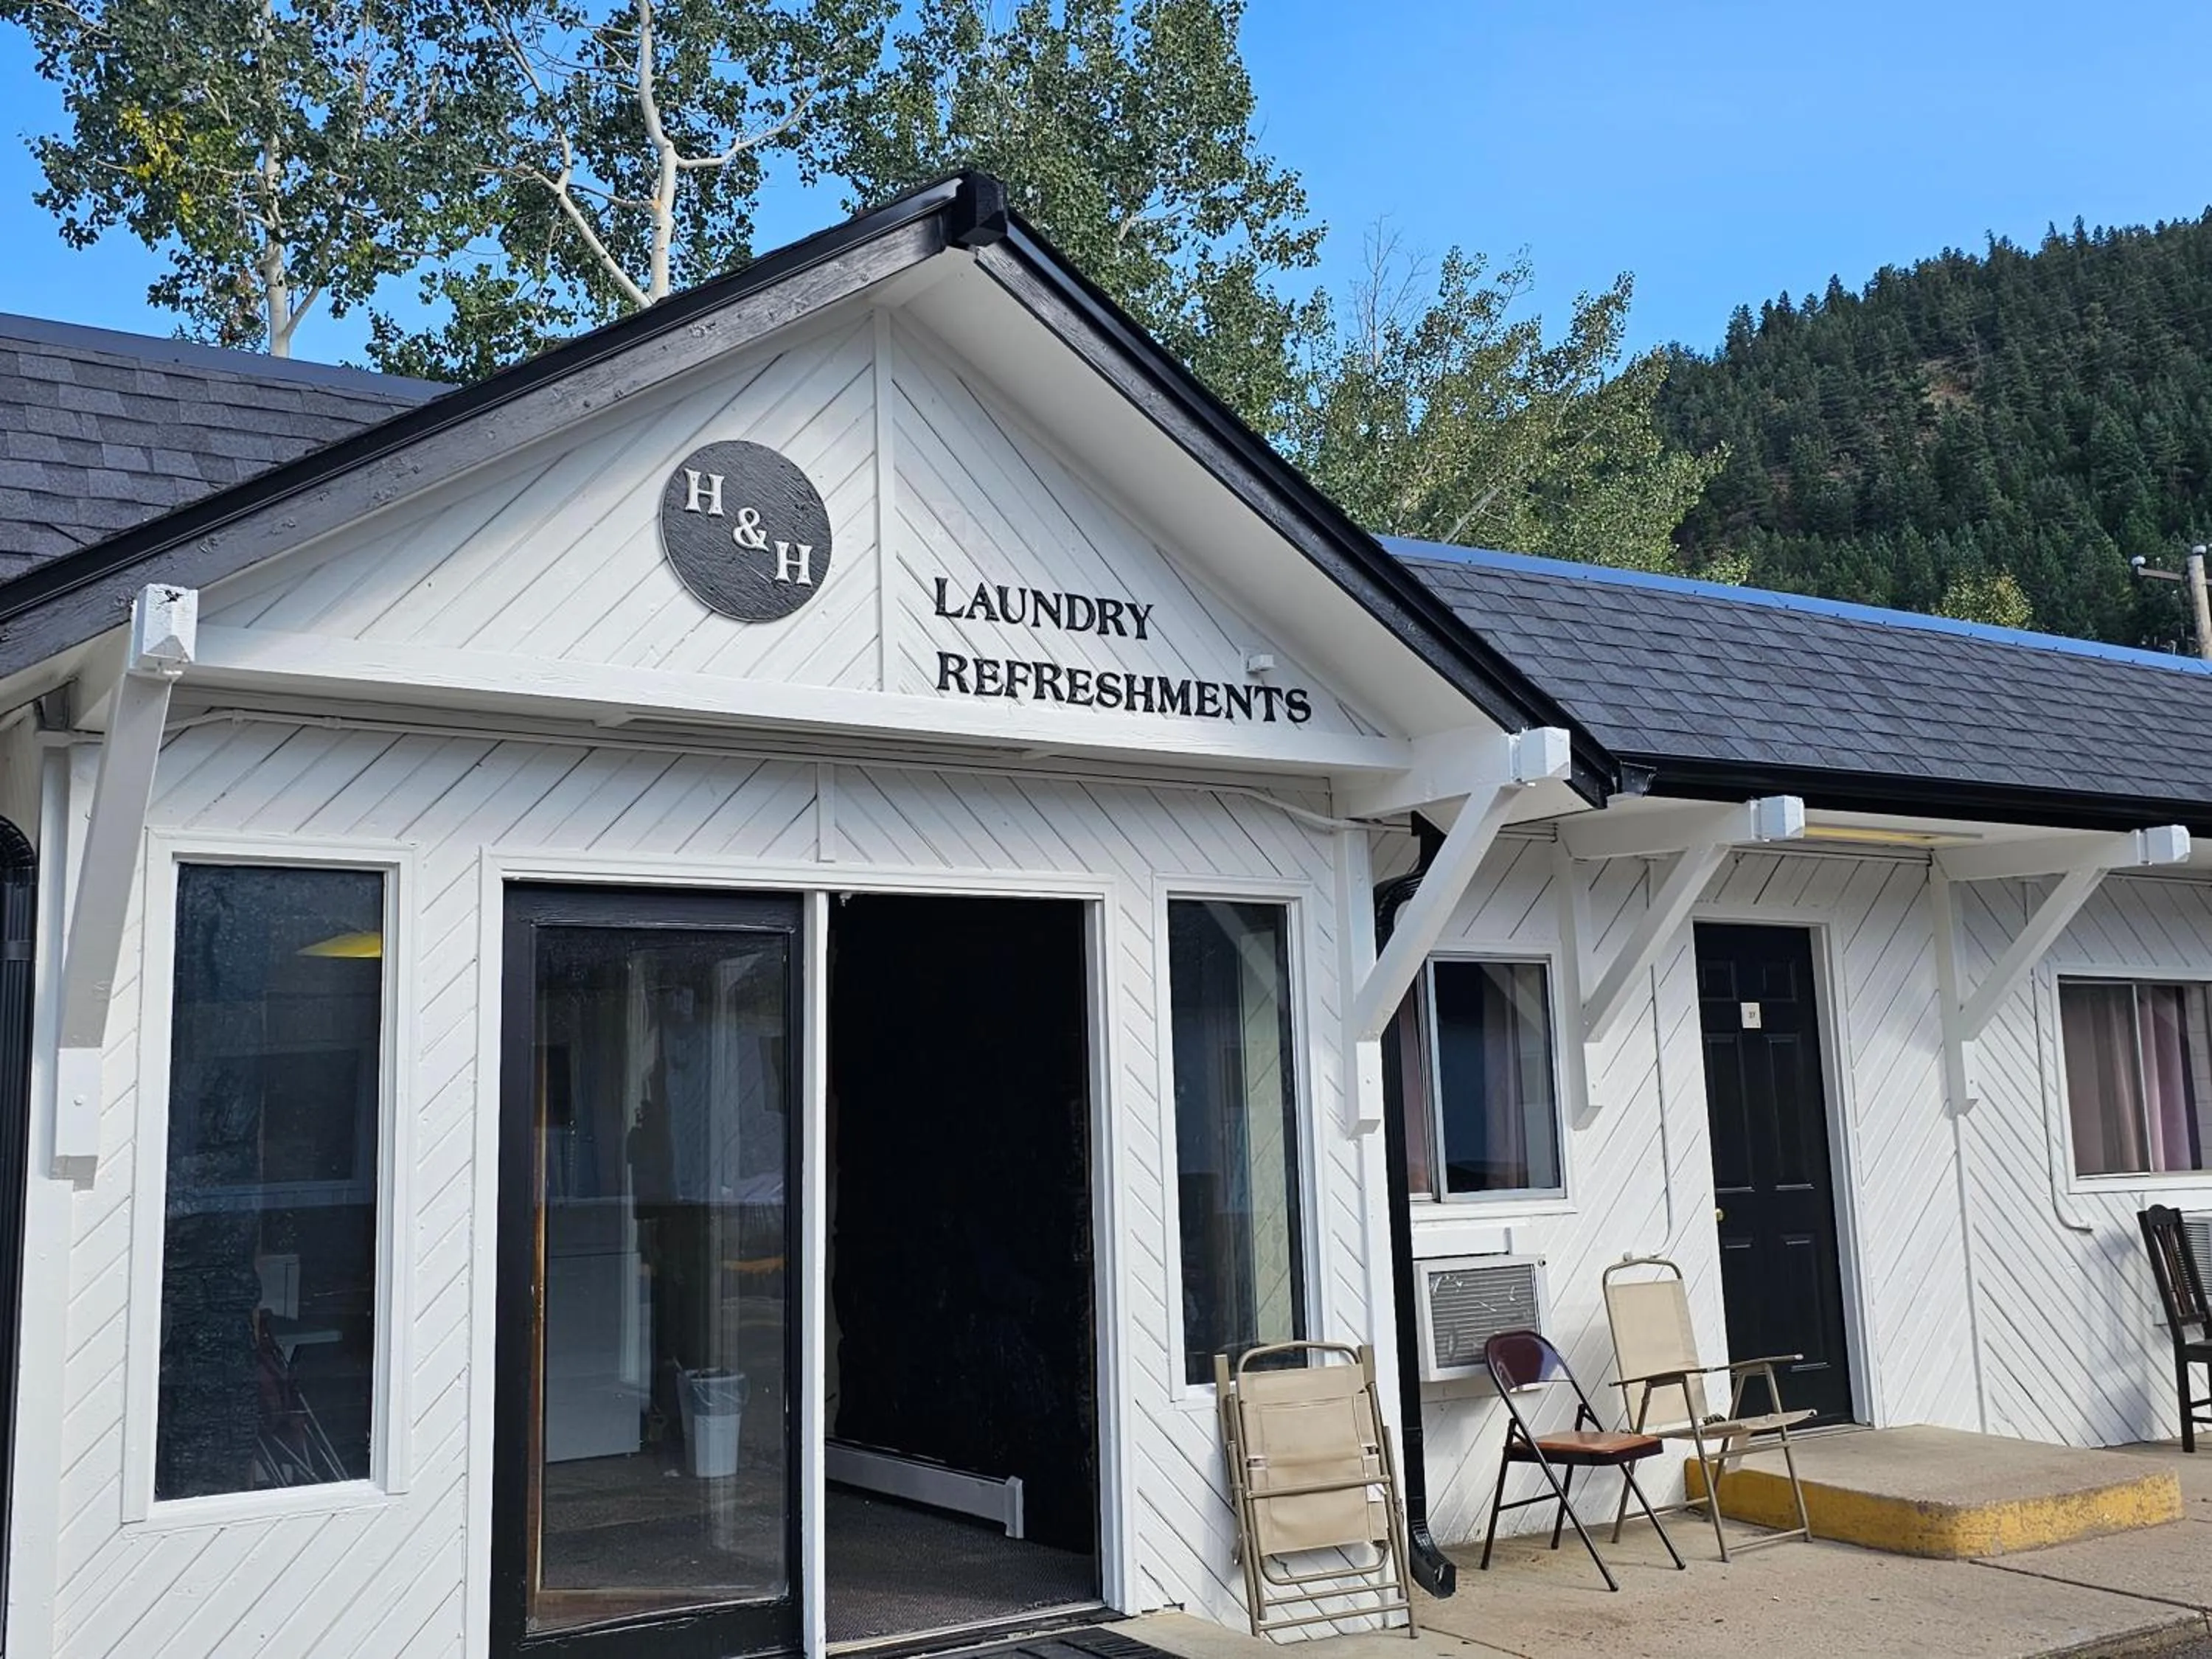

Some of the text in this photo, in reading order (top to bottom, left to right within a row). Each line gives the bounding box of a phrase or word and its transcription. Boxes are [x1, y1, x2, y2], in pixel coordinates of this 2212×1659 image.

[685, 468, 811, 586] H & H
[935, 577, 1153, 639] LAUNDRY
[936, 651, 1312, 723] REFRESHMENTS
